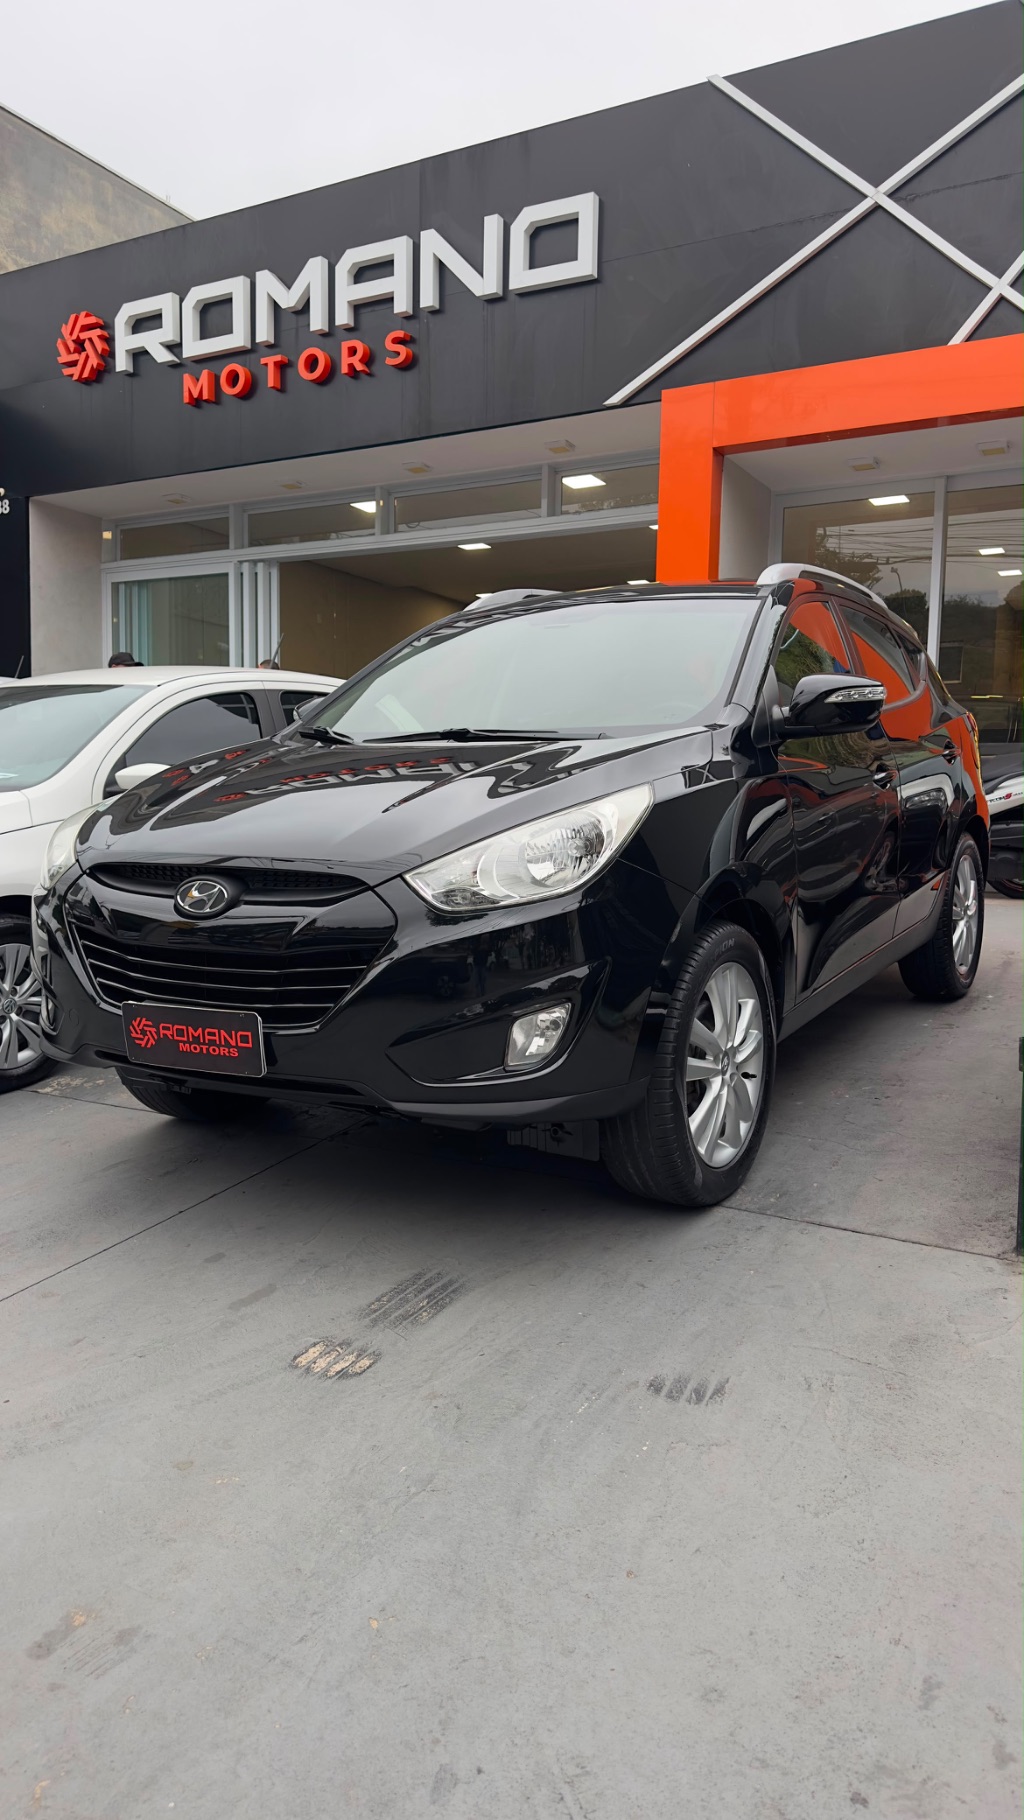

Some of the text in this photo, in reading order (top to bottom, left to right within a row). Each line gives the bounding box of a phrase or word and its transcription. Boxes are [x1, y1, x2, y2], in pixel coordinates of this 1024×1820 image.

[115, 191, 599, 374] ROMANO
[183, 330, 413, 406] MOTORS
[160, 1023, 252, 1048] ROMANO
[179, 1042, 239, 1057] MOTORS
